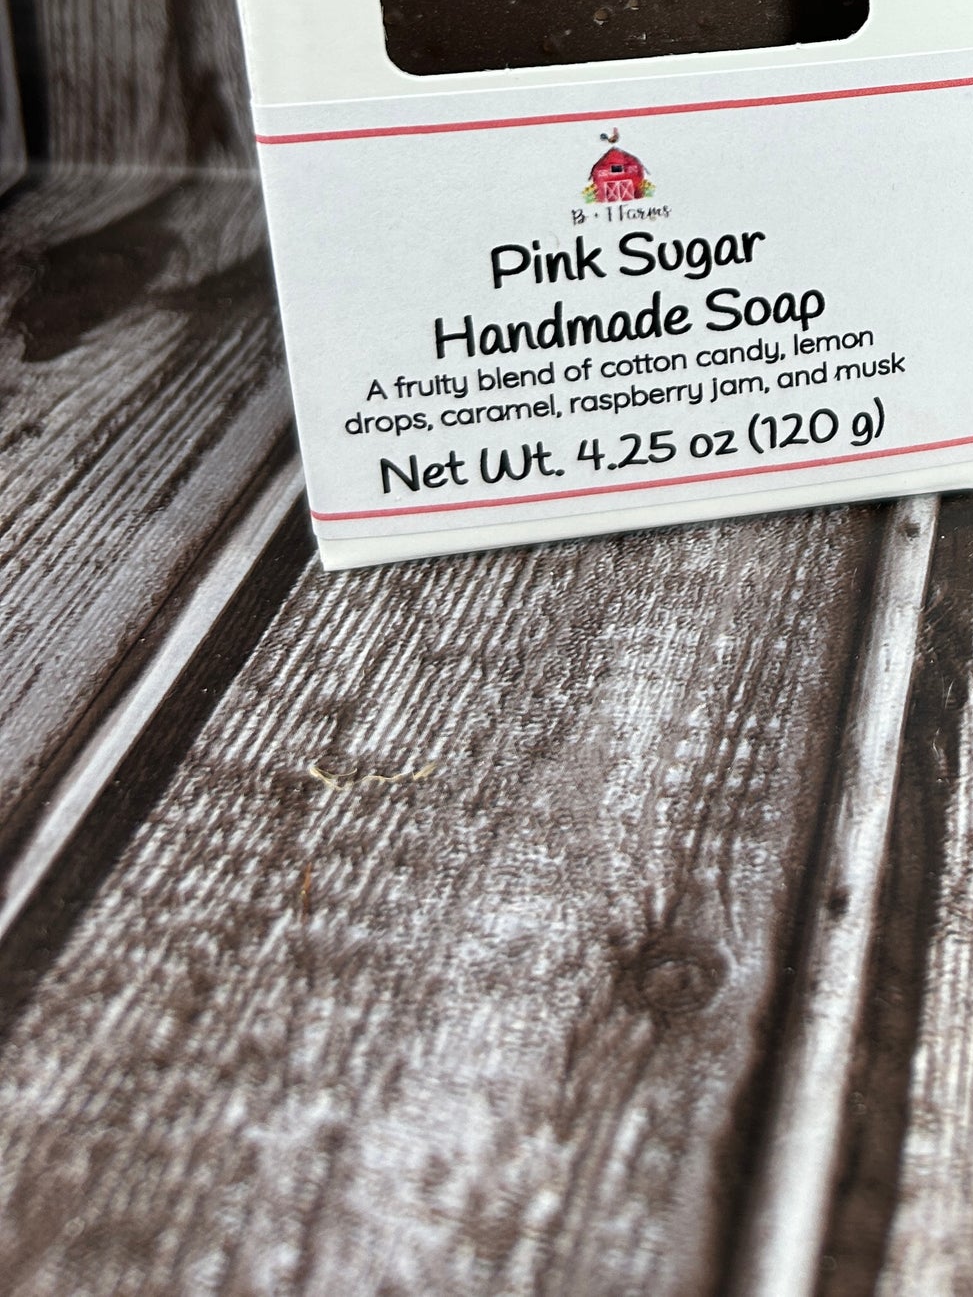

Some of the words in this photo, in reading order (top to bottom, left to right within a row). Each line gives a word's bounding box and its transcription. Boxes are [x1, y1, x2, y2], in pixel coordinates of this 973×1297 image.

[490, 235, 606, 290] Pink
[618, 231, 766, 281] Sugar
[434, 290, 693, 360] Handmade
[705, 287, 826, 332] Soap
[344, 411, 434, 437] drops,
[440, 393, 563, 427] caramel,
[569, 382, 703, 415] raspberry
[709, 376, 770, 404] jam,
[776, 361, 828, 389] and
[833, 351, 906, 382] musk
[366, 379, 388, 402] A
[393, 374, 469, 399] fruity
[477, 361, 555, 392] blend
[563, 357, 593, 382] of
[600, 353, 688, 379] cotton
[695, 337, 786, 368] candy,
[793, 330, 874, 356] lemon
[379, 450, 469, 495] Net
[480, 440, 566, 484] Wt.
[576, 430, 677, 471] 4.25
[689, 429, 739, 459] oz
[747, 408, 839, 455] (120
[850, 396, 885, 447] g)
